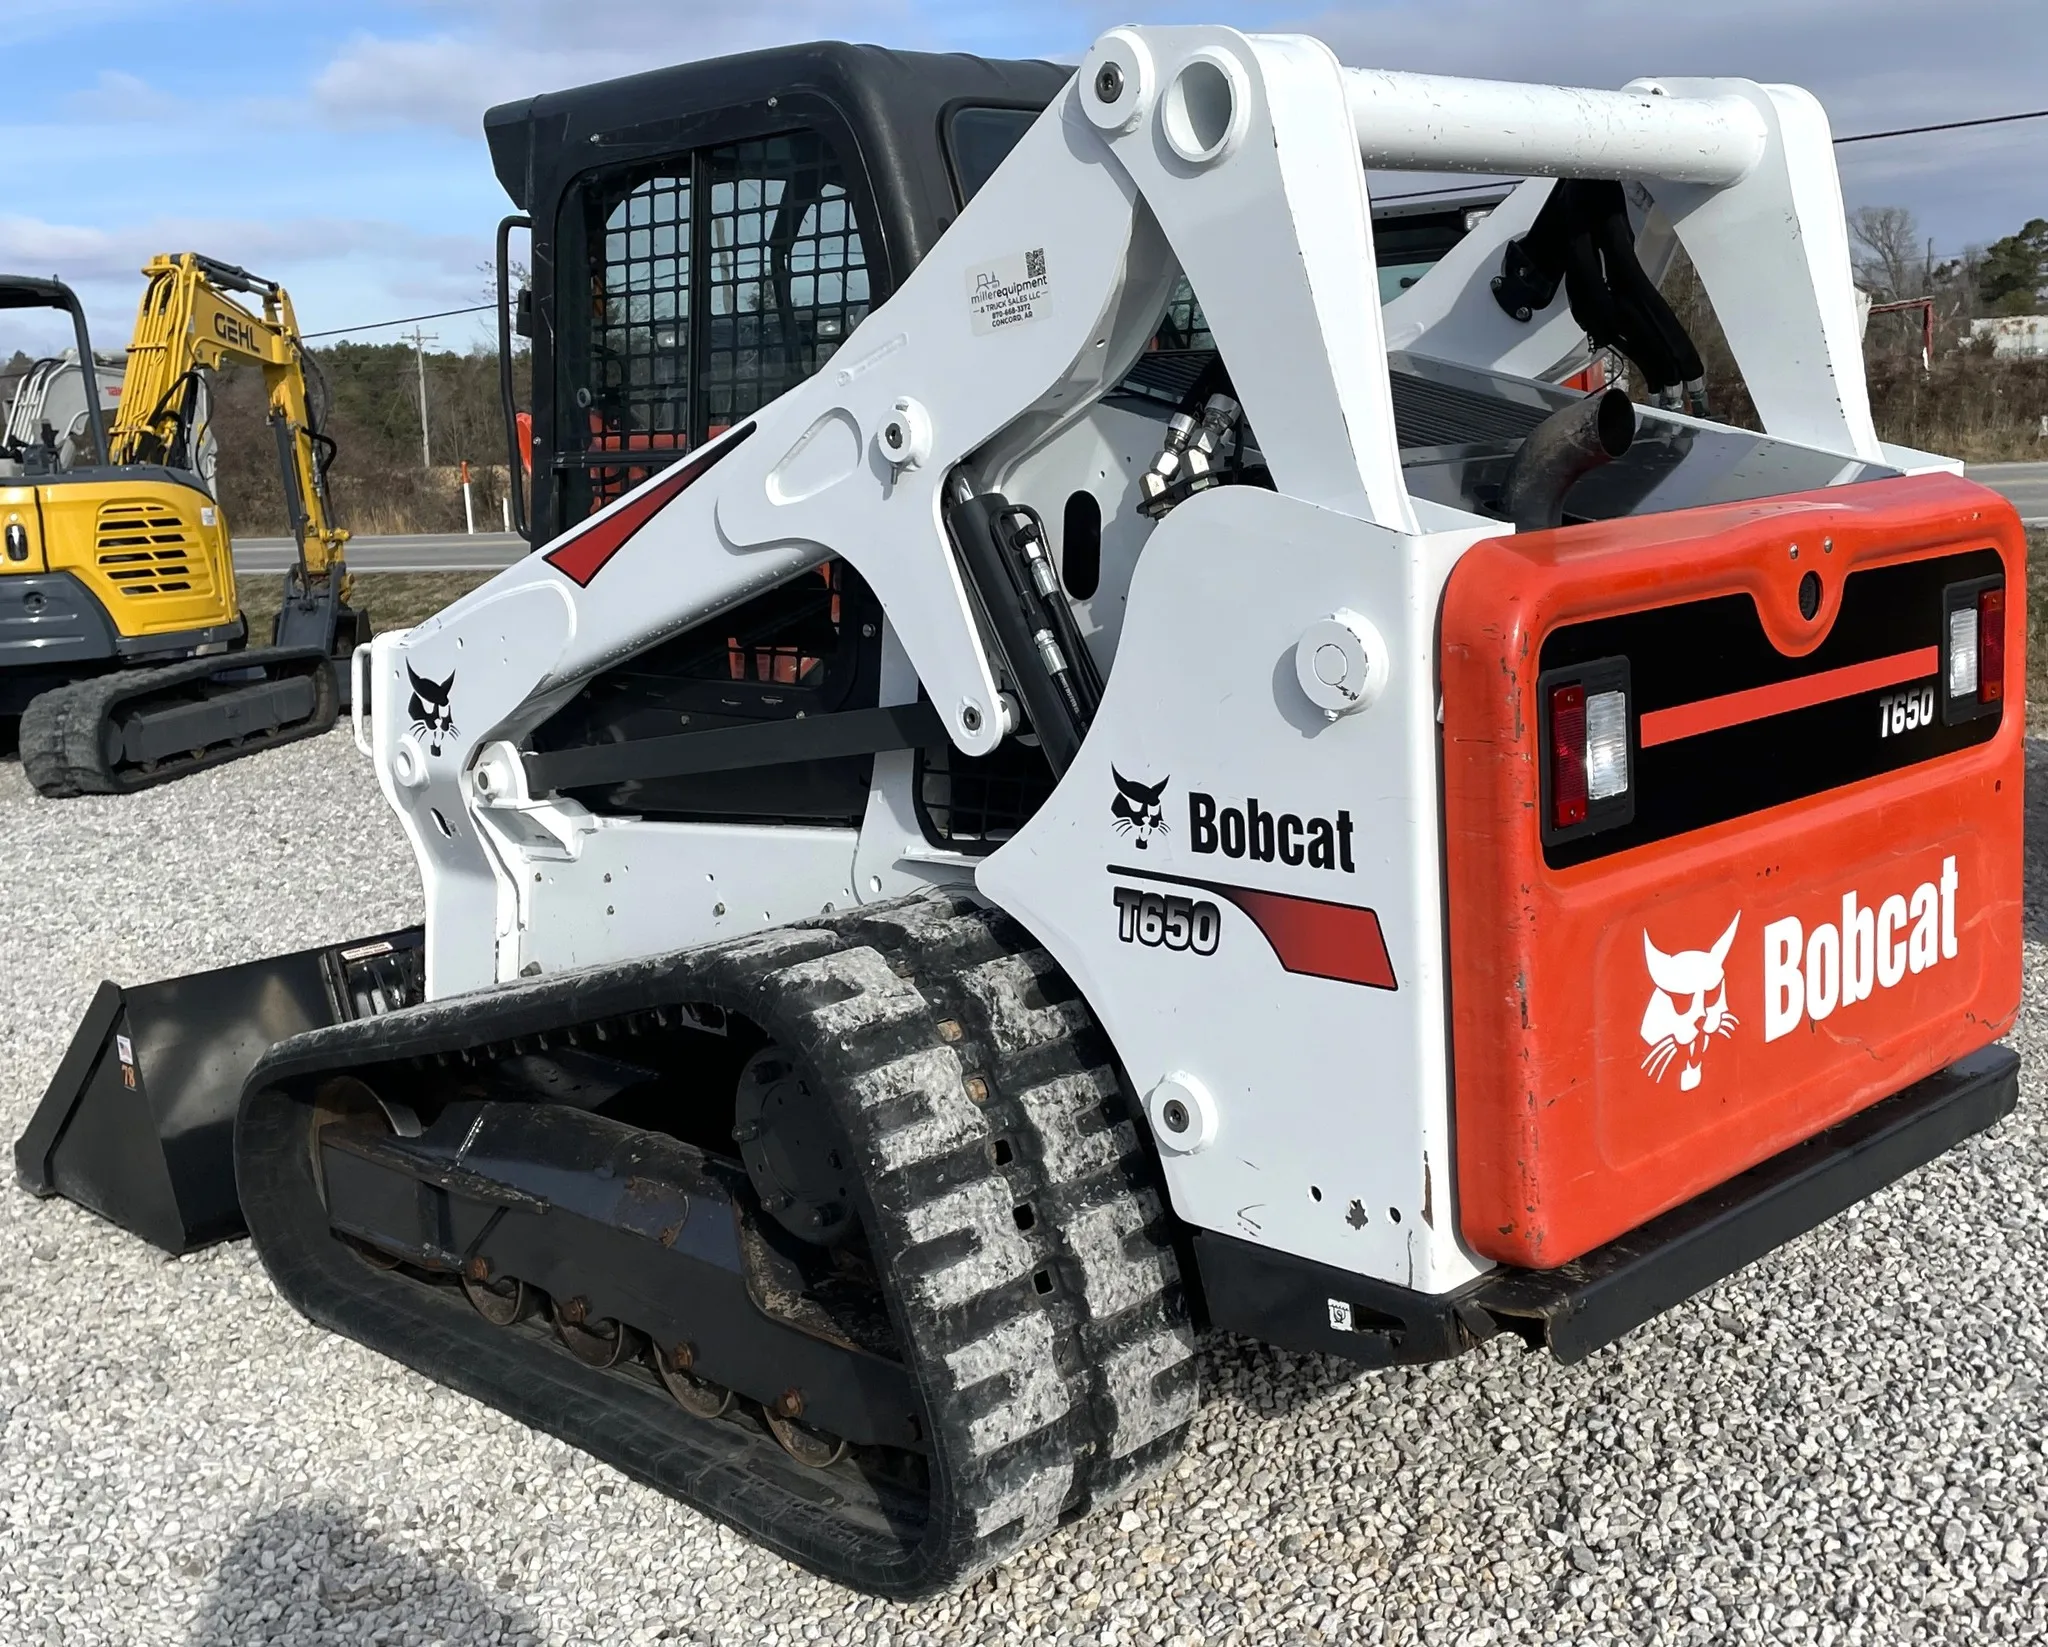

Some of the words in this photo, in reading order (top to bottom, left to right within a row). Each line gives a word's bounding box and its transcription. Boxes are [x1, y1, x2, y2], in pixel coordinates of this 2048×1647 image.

[971, 275, 1048, 304] millerequipment
[986, 300, 1007, 312] TRUCK
[1008, 294, 1028, 307] SALES
[1028, 291, 1041, 301] LLC
[992, 303, 1031, 319] 870-668-3372
[1024, 310, 1033, 319] AR
[214, 312, 261, 353] GEHL
[1879, 686, 1934, 738] T650
[1188, 791, 1355, 874] Bobcat
[1113, 886, 1221, 956] T650
[1764, 854, 1959, 1043] Bobcat
[121, 1064, 136, 1088] 78
